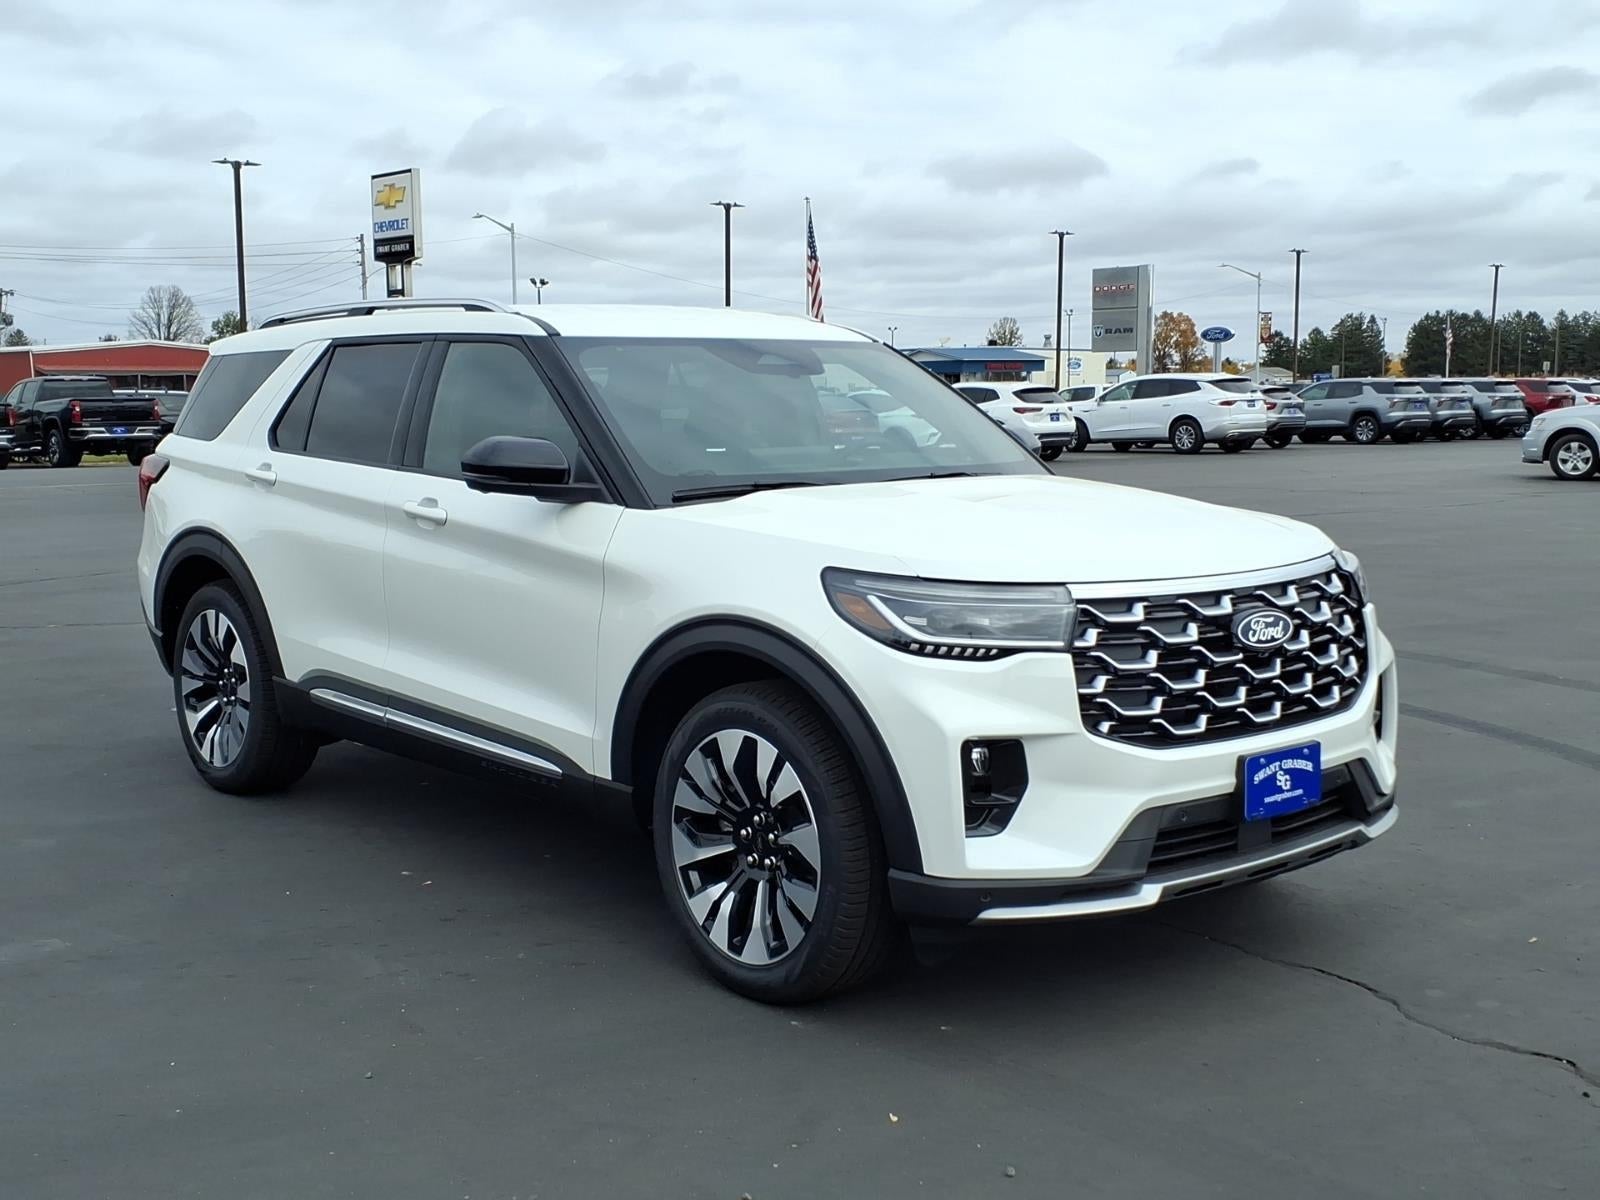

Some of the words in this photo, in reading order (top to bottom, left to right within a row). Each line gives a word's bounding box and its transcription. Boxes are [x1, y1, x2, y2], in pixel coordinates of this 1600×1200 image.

[374, 218, 409, 233] CHEVROLET
[1206, 329, 1226, 340] Ford
[1249, 617, 1284, 642] Ford
[1253, 761, 1281, 785] SWANT
[1281, 759, 1314, 772] GRABER
